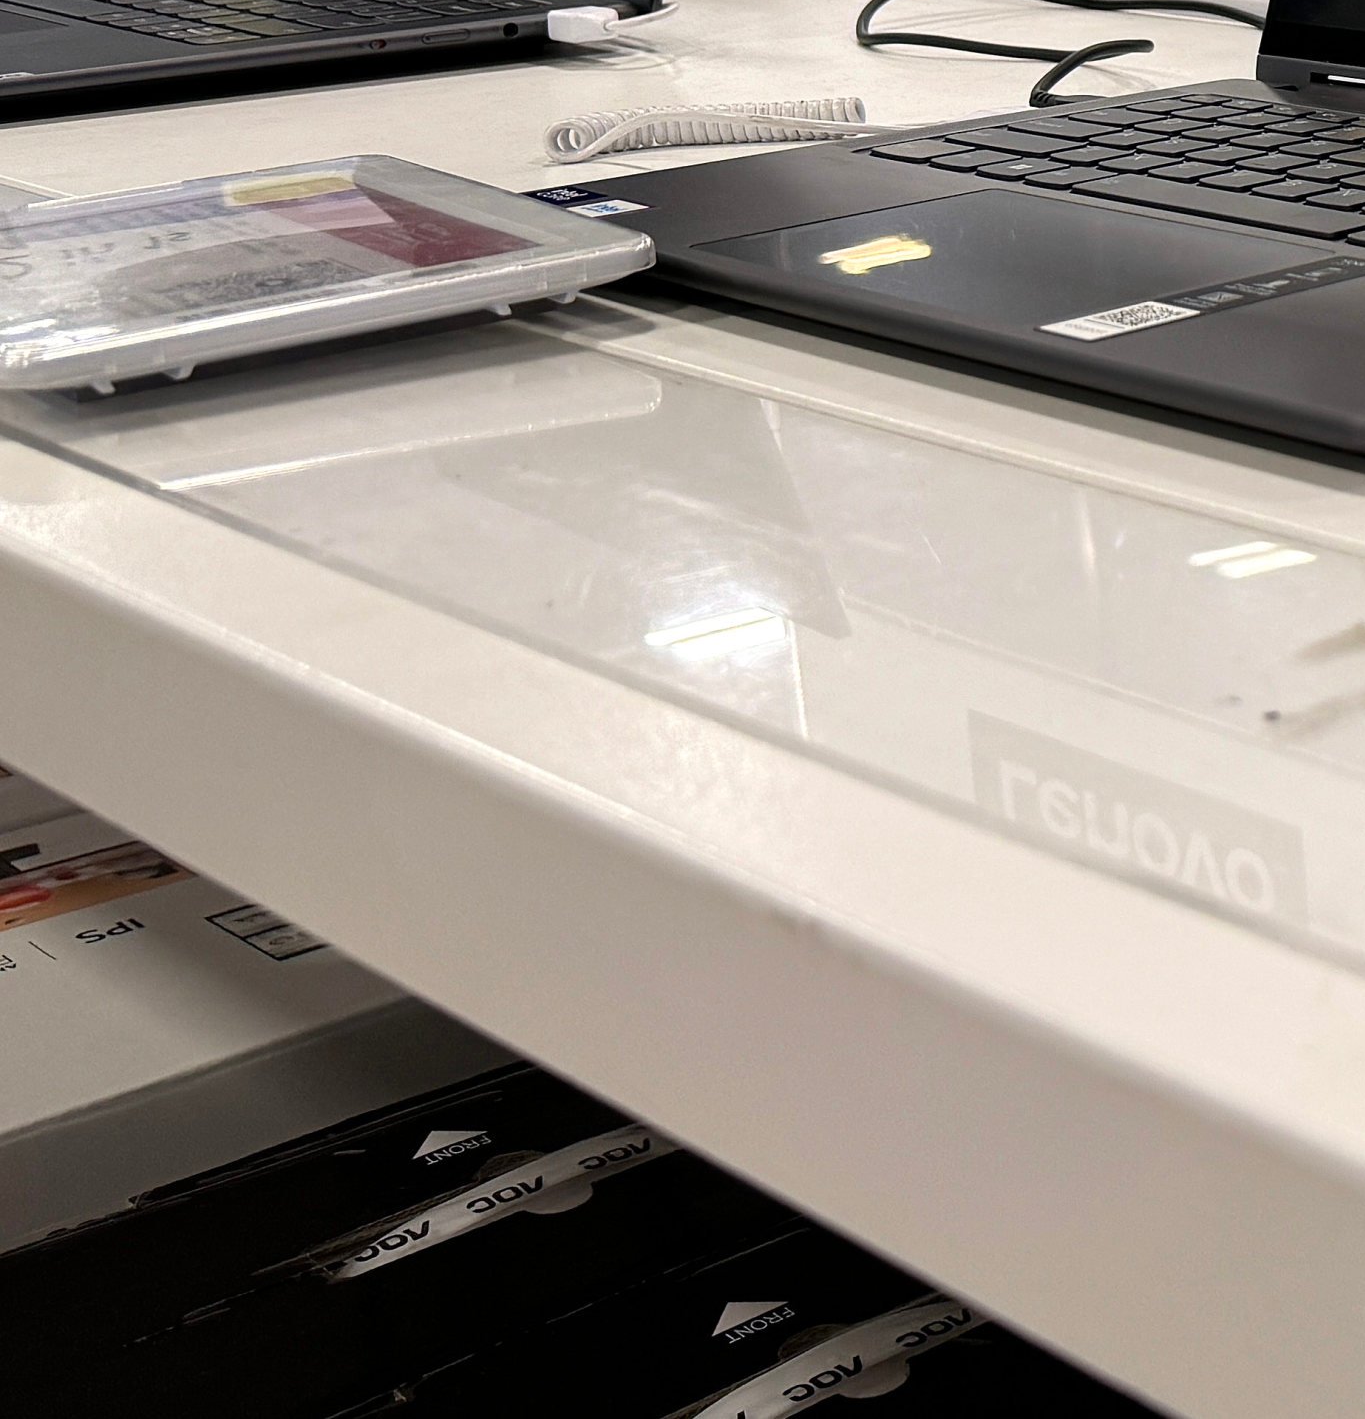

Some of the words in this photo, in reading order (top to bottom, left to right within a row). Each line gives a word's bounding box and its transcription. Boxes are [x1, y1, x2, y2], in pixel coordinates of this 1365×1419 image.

[75, 917, 147, 944] IPS
[425, 1133, 492, 1166] FRONT
[577, 1137, 651, 1171] AOC
[465, 1174, 544, 1215] AOC
[725, 1306, 796, 1345] FRONT
[782, 1354, 864, 1403] AOC
